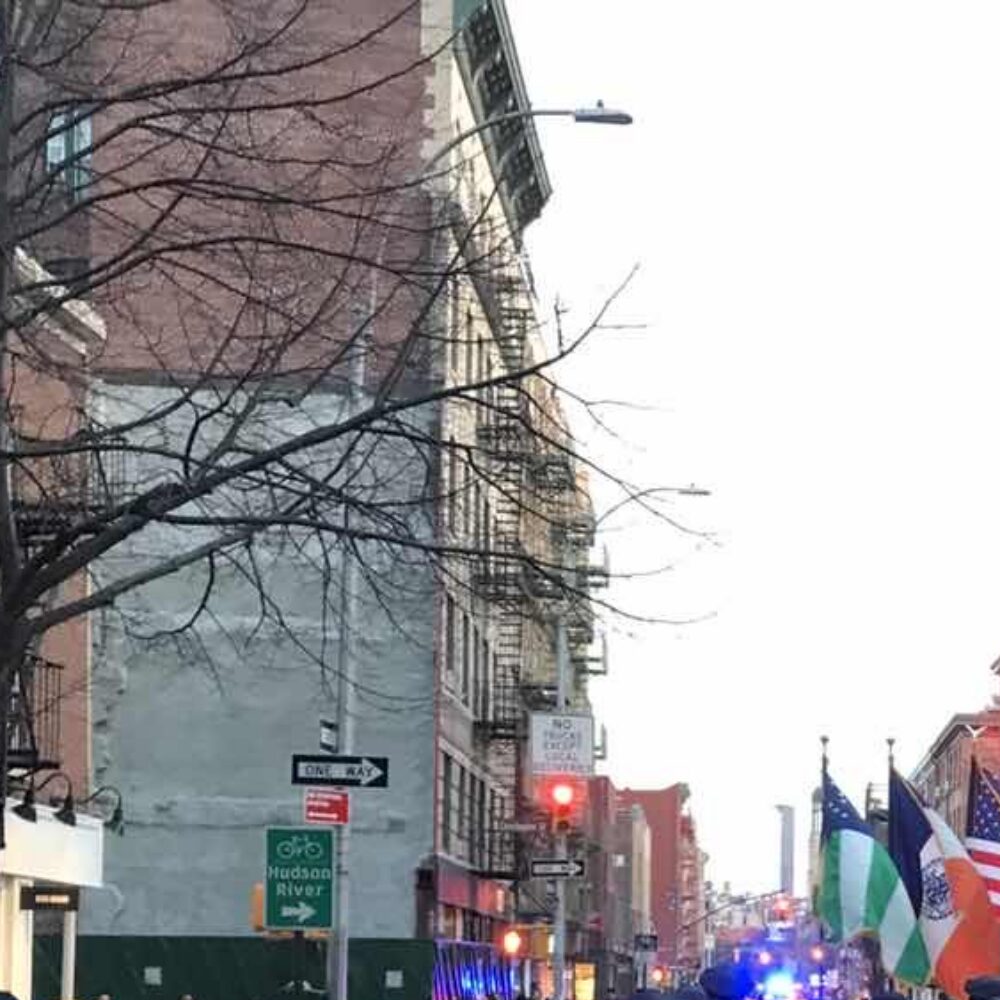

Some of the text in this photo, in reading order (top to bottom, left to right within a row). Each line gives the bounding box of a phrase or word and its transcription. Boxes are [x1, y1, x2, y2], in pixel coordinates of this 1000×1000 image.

[552, 719, 572, 729] NO
[304, 765, 375, 777] ONE WAY
[267, 866, 332, 880] Hudson
[276, 882, 325, 897] River
